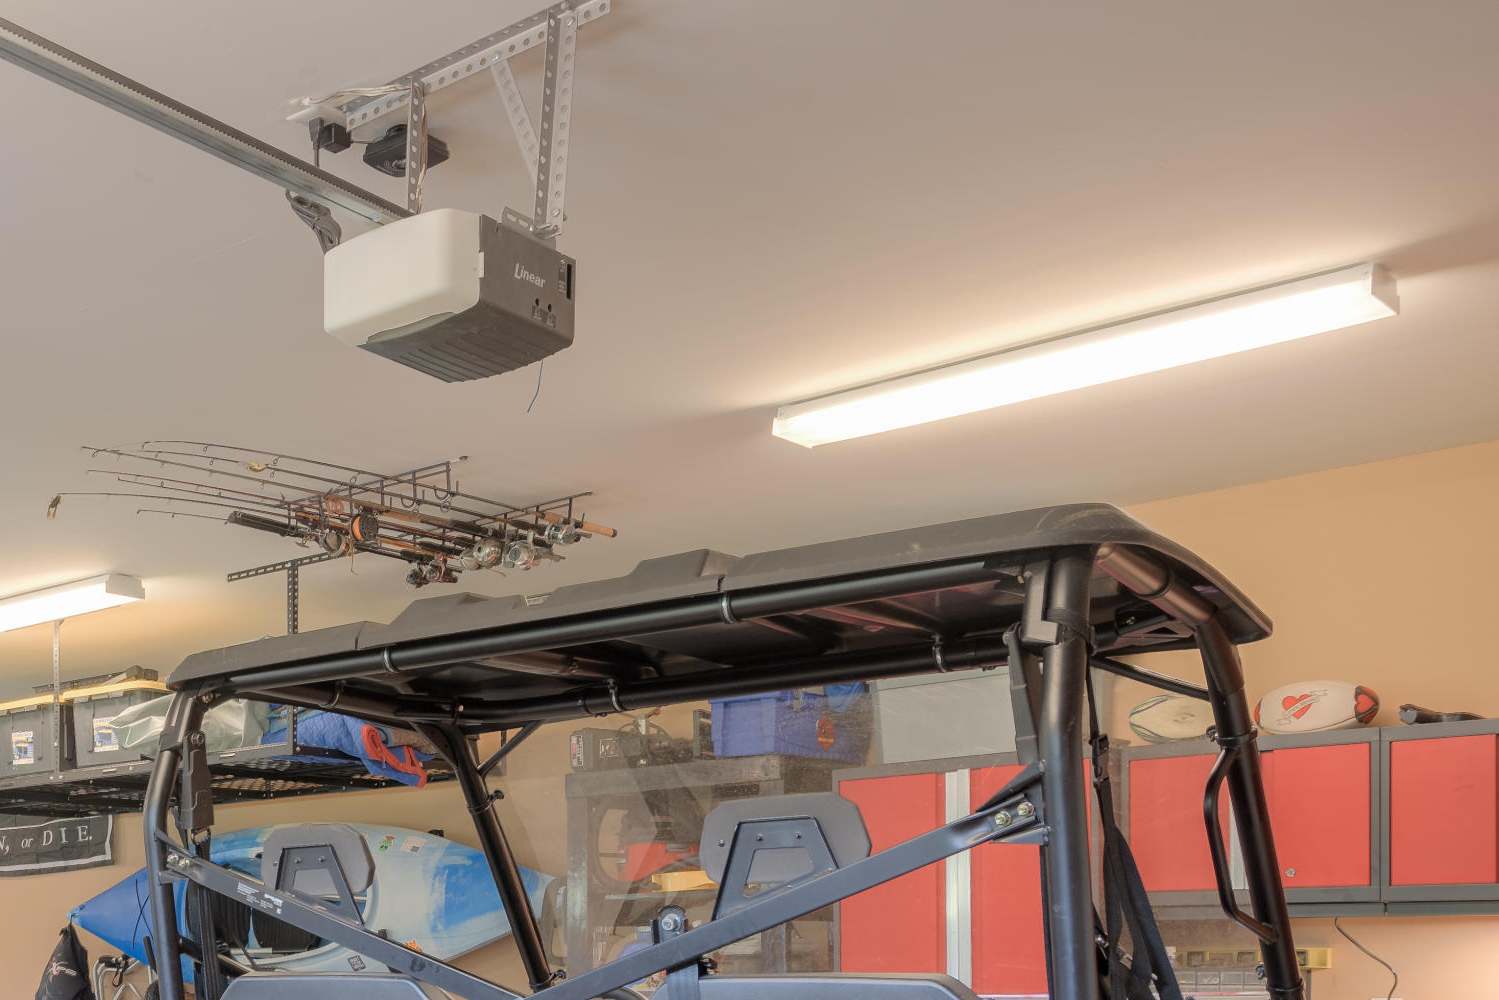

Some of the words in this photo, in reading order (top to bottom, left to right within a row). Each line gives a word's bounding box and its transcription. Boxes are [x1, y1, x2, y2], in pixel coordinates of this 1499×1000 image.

[514, 262, 546, 288] Linear
[21, 837, 33, 848] or
[42, 826, 93, 846] DIE.
